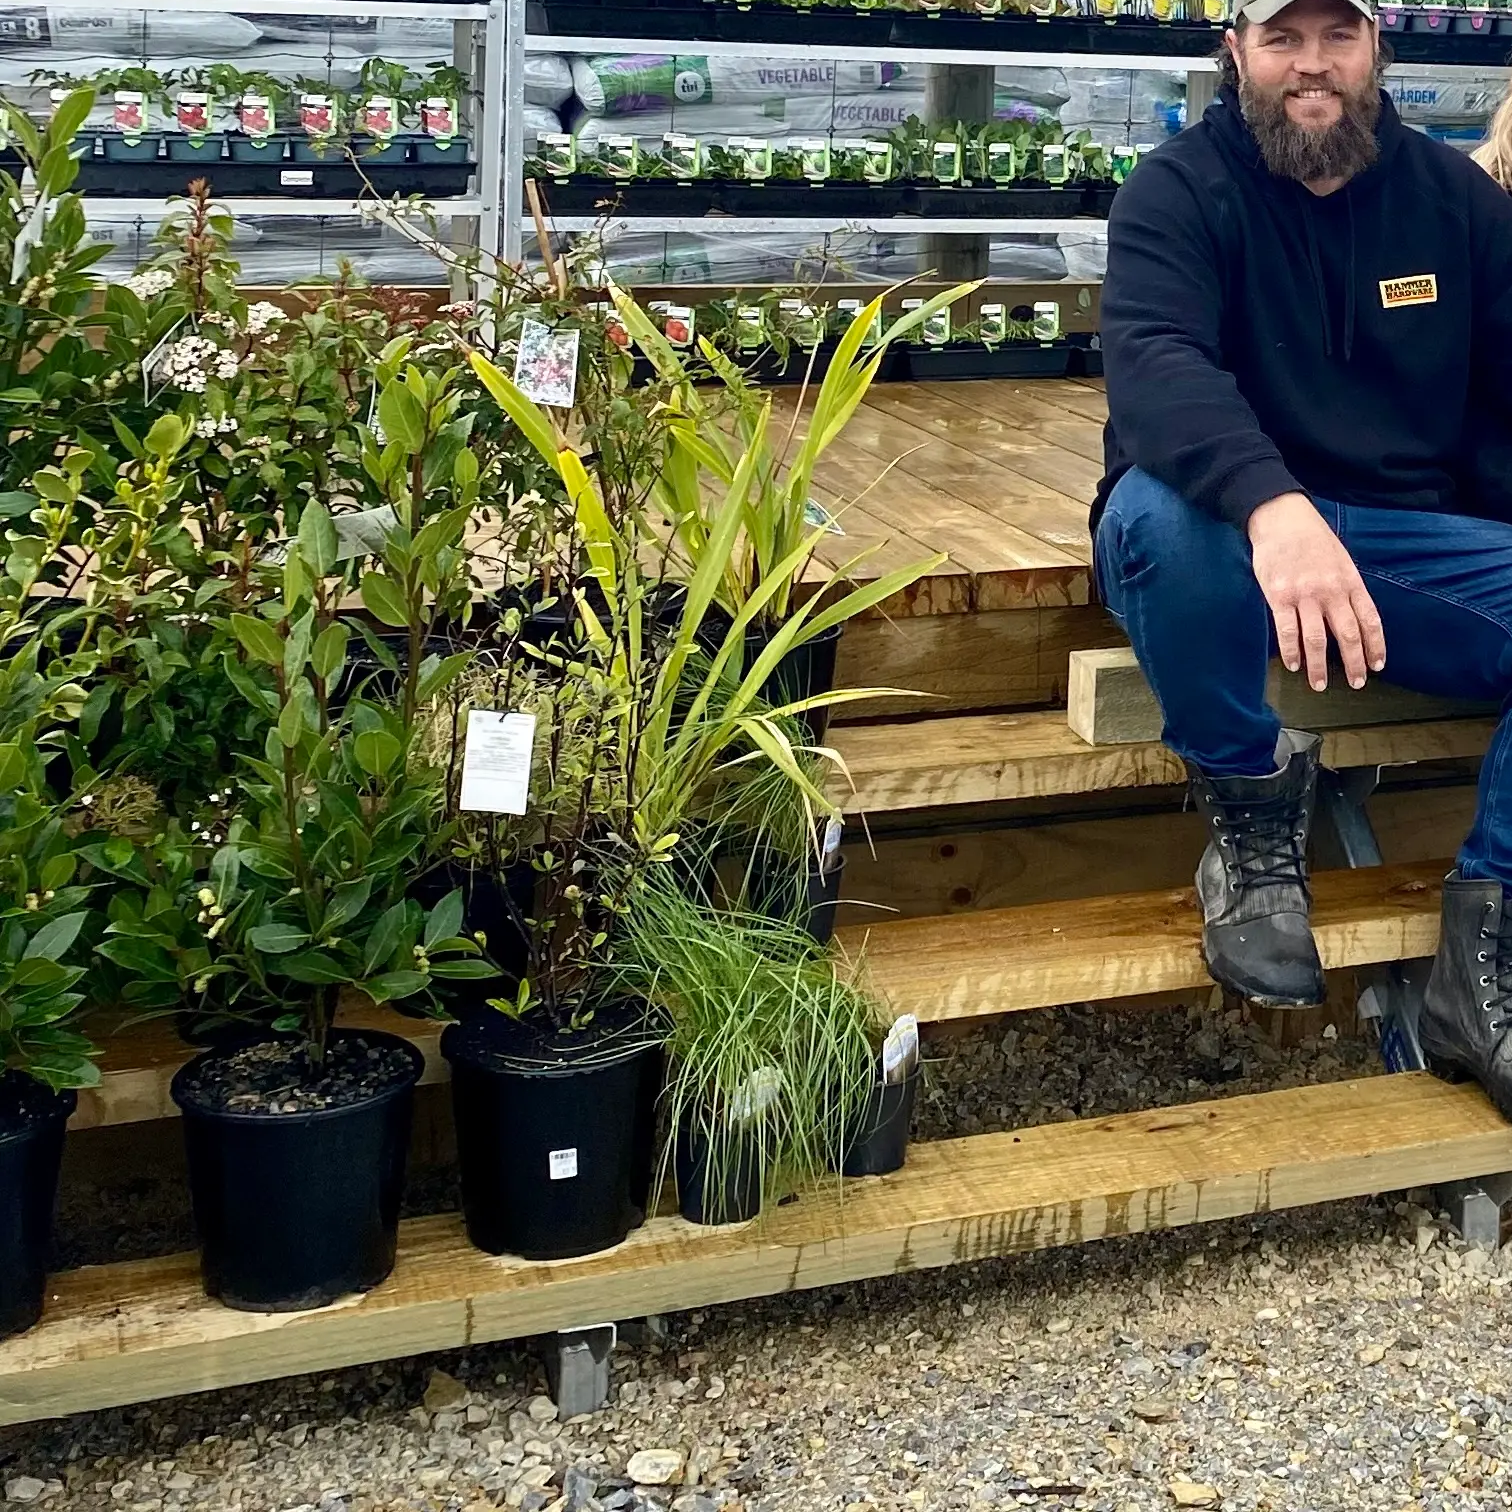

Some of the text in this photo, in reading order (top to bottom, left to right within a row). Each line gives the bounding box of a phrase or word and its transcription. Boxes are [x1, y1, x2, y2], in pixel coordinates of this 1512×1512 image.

[758, 67, 833, 85] VEGETABLE
[1392, 89, 1437, 105] GARDEN
[833, 105, 906, 123] VEGETABLE
[1384, 279, 1433, 292] HAMMER
[1385, 288, 1434, 300] HARDWARE
